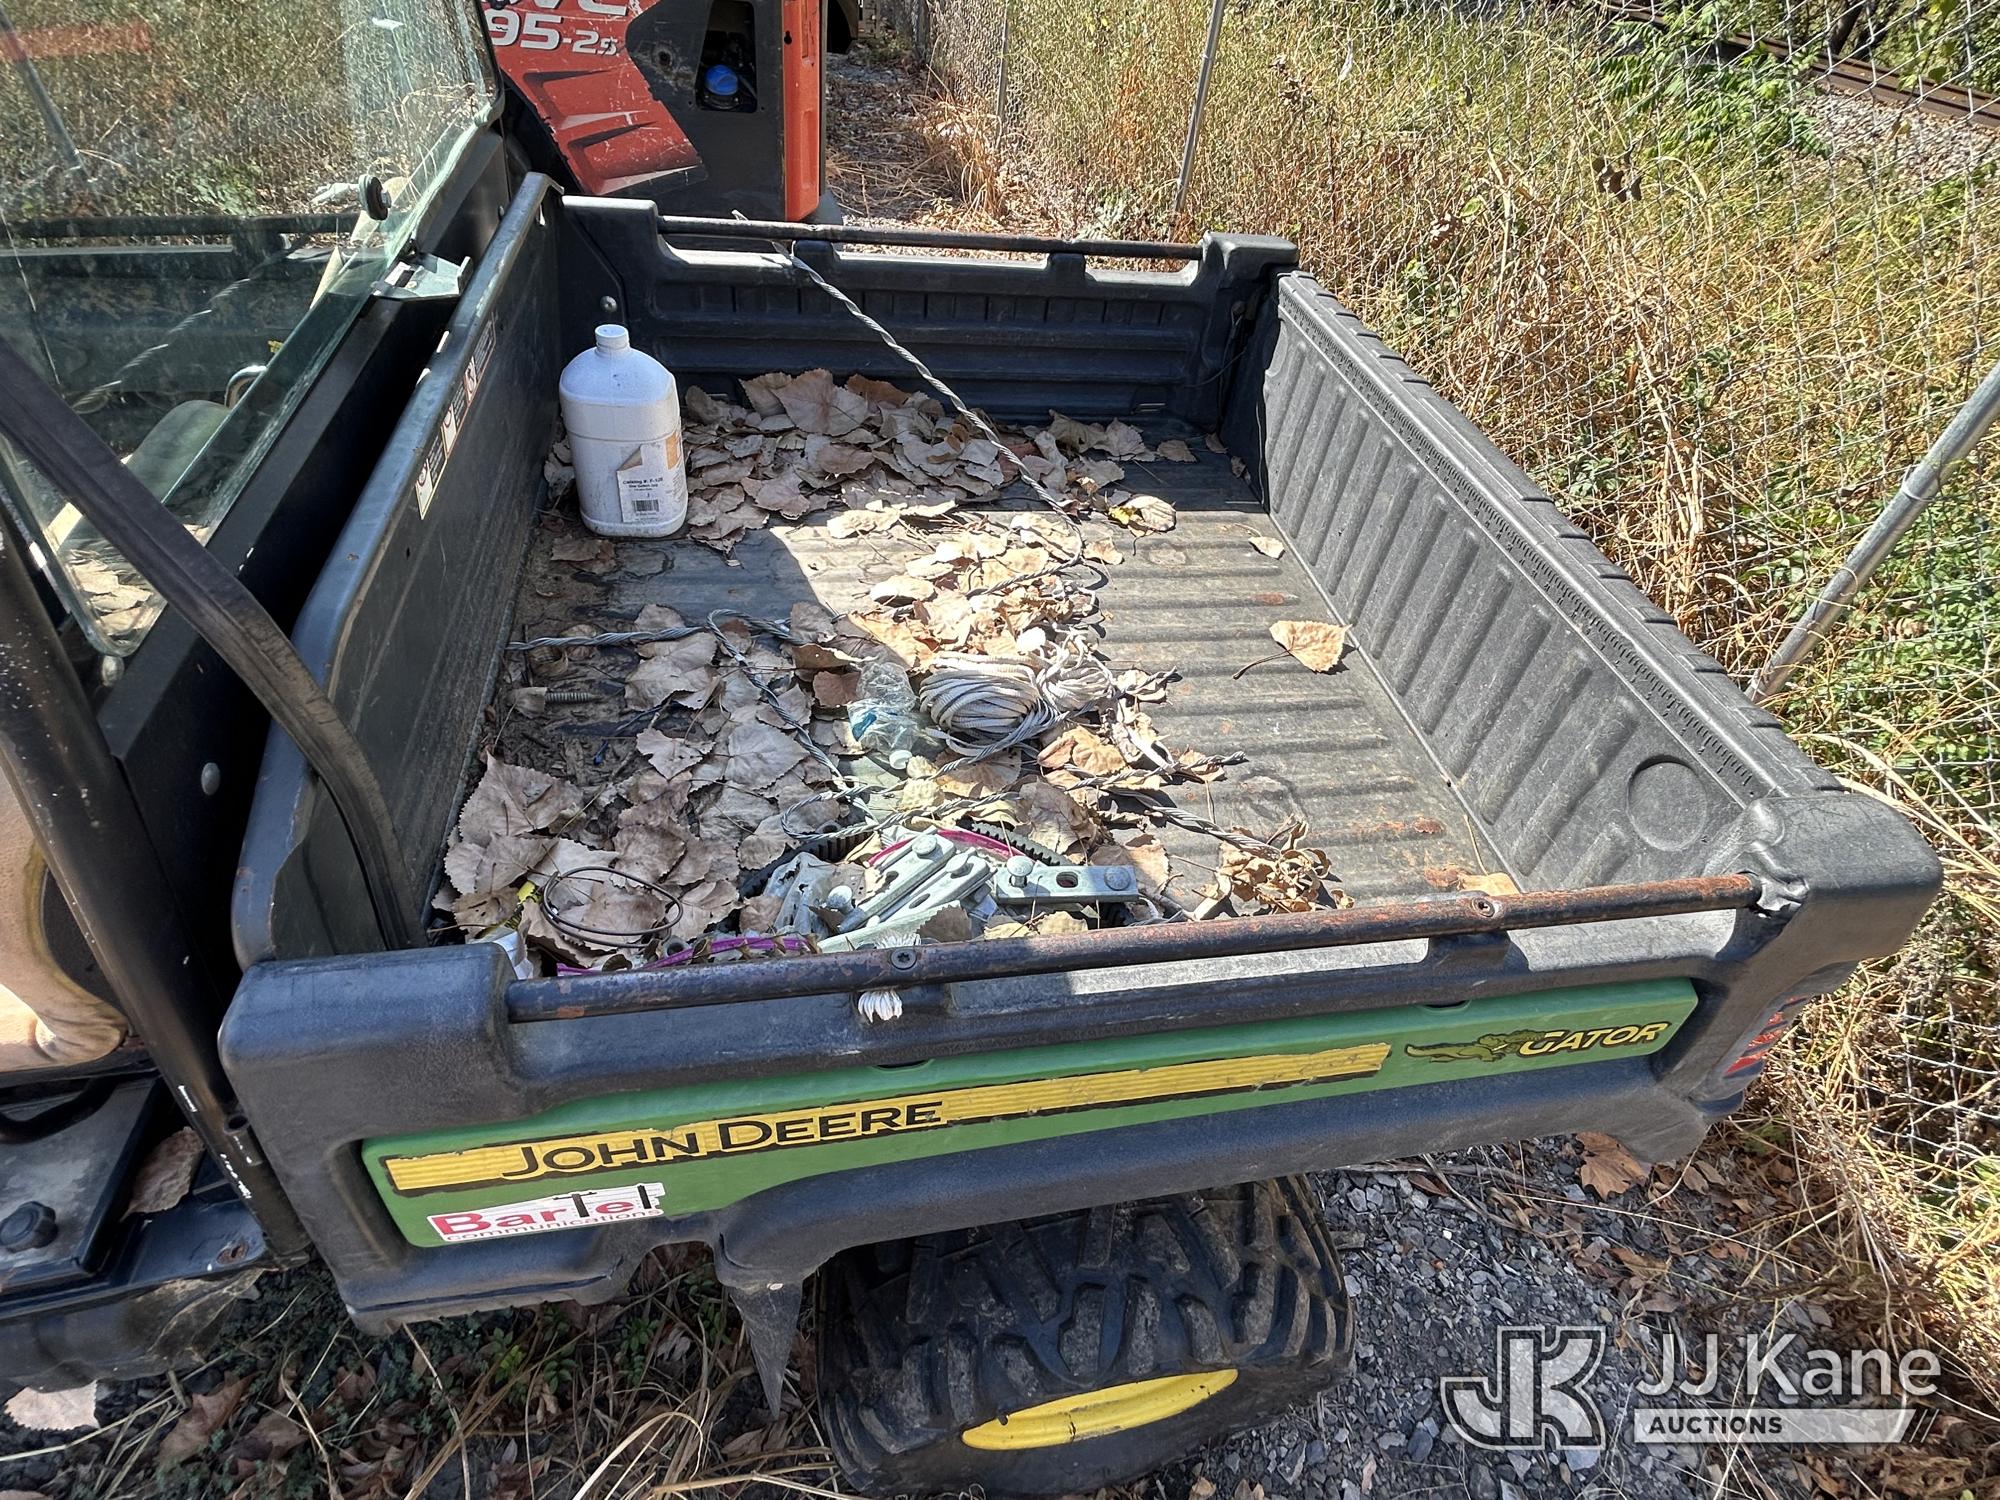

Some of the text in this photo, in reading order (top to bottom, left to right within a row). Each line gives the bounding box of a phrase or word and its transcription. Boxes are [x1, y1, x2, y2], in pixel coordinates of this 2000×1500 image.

[1517, 1021, 1671, 1056] GATOR
[501, 1101, 943, 1178] JOHN DEERE
[446, 1209, 663, 1241] communications
